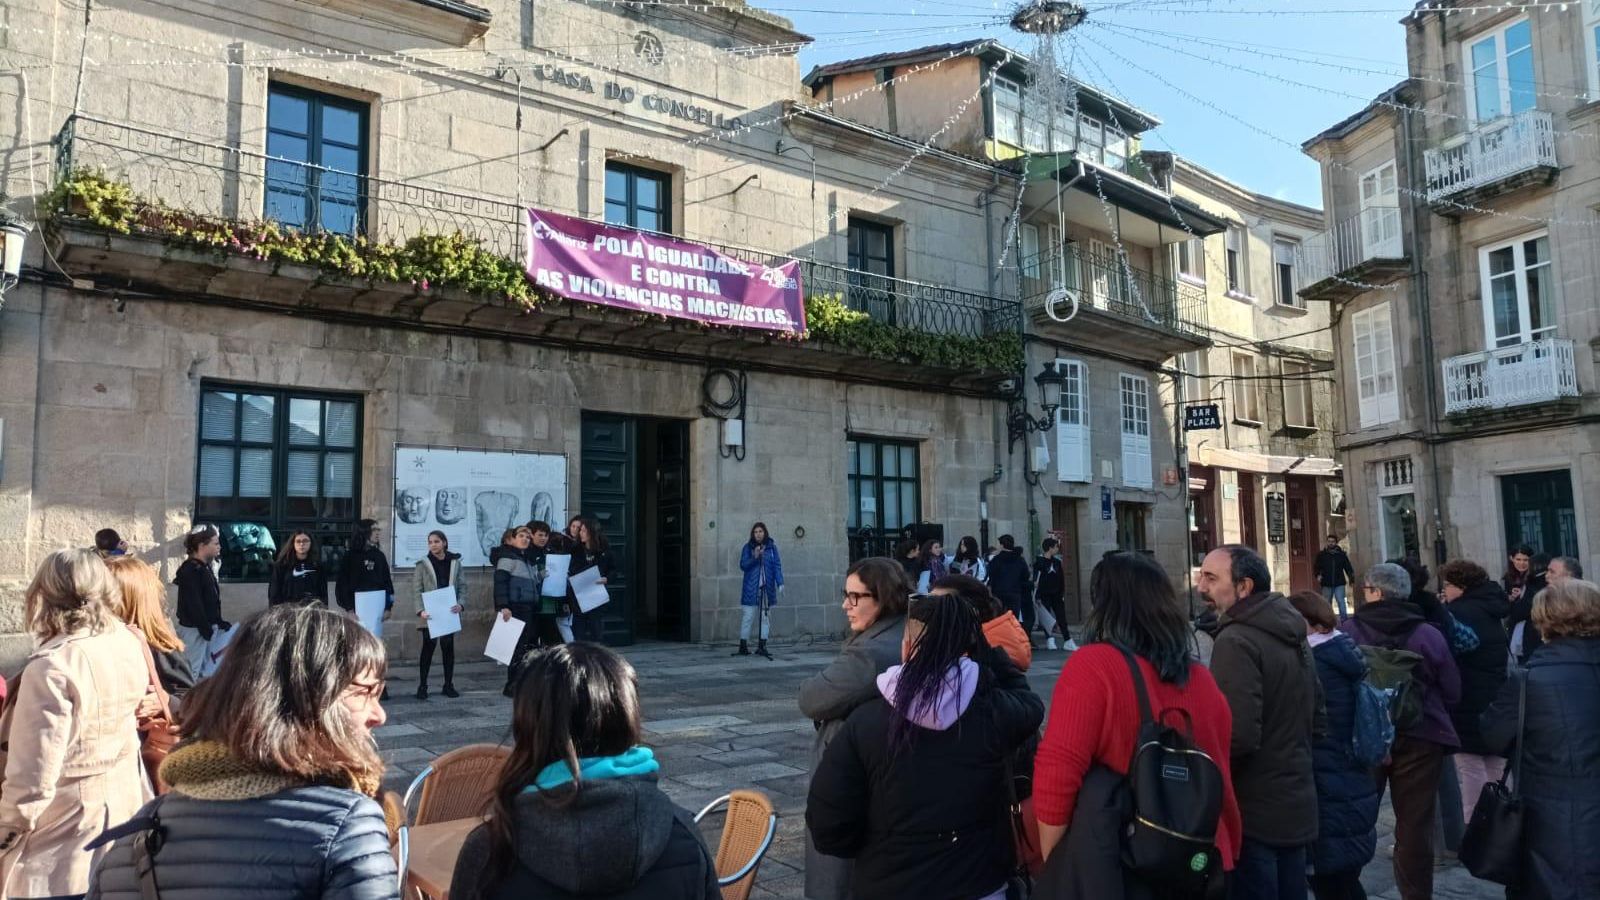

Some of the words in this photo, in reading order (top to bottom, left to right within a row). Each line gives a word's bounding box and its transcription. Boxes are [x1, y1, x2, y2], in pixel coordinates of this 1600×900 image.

[541, 64, 594, 93] CASA
[607, 82, 634, 103] DO
[594, 236, 644, 259] POLA
[536, 269, 565, 290] AS
[569, 275, 683, 312] VIOLENCIAS
[631, 266, 642, 281] E
[646, 267, 720, 295] CONTRA
[1188, 418, 1216, 426] PLAZA
[1192, 408, 1211, 416] BAR
